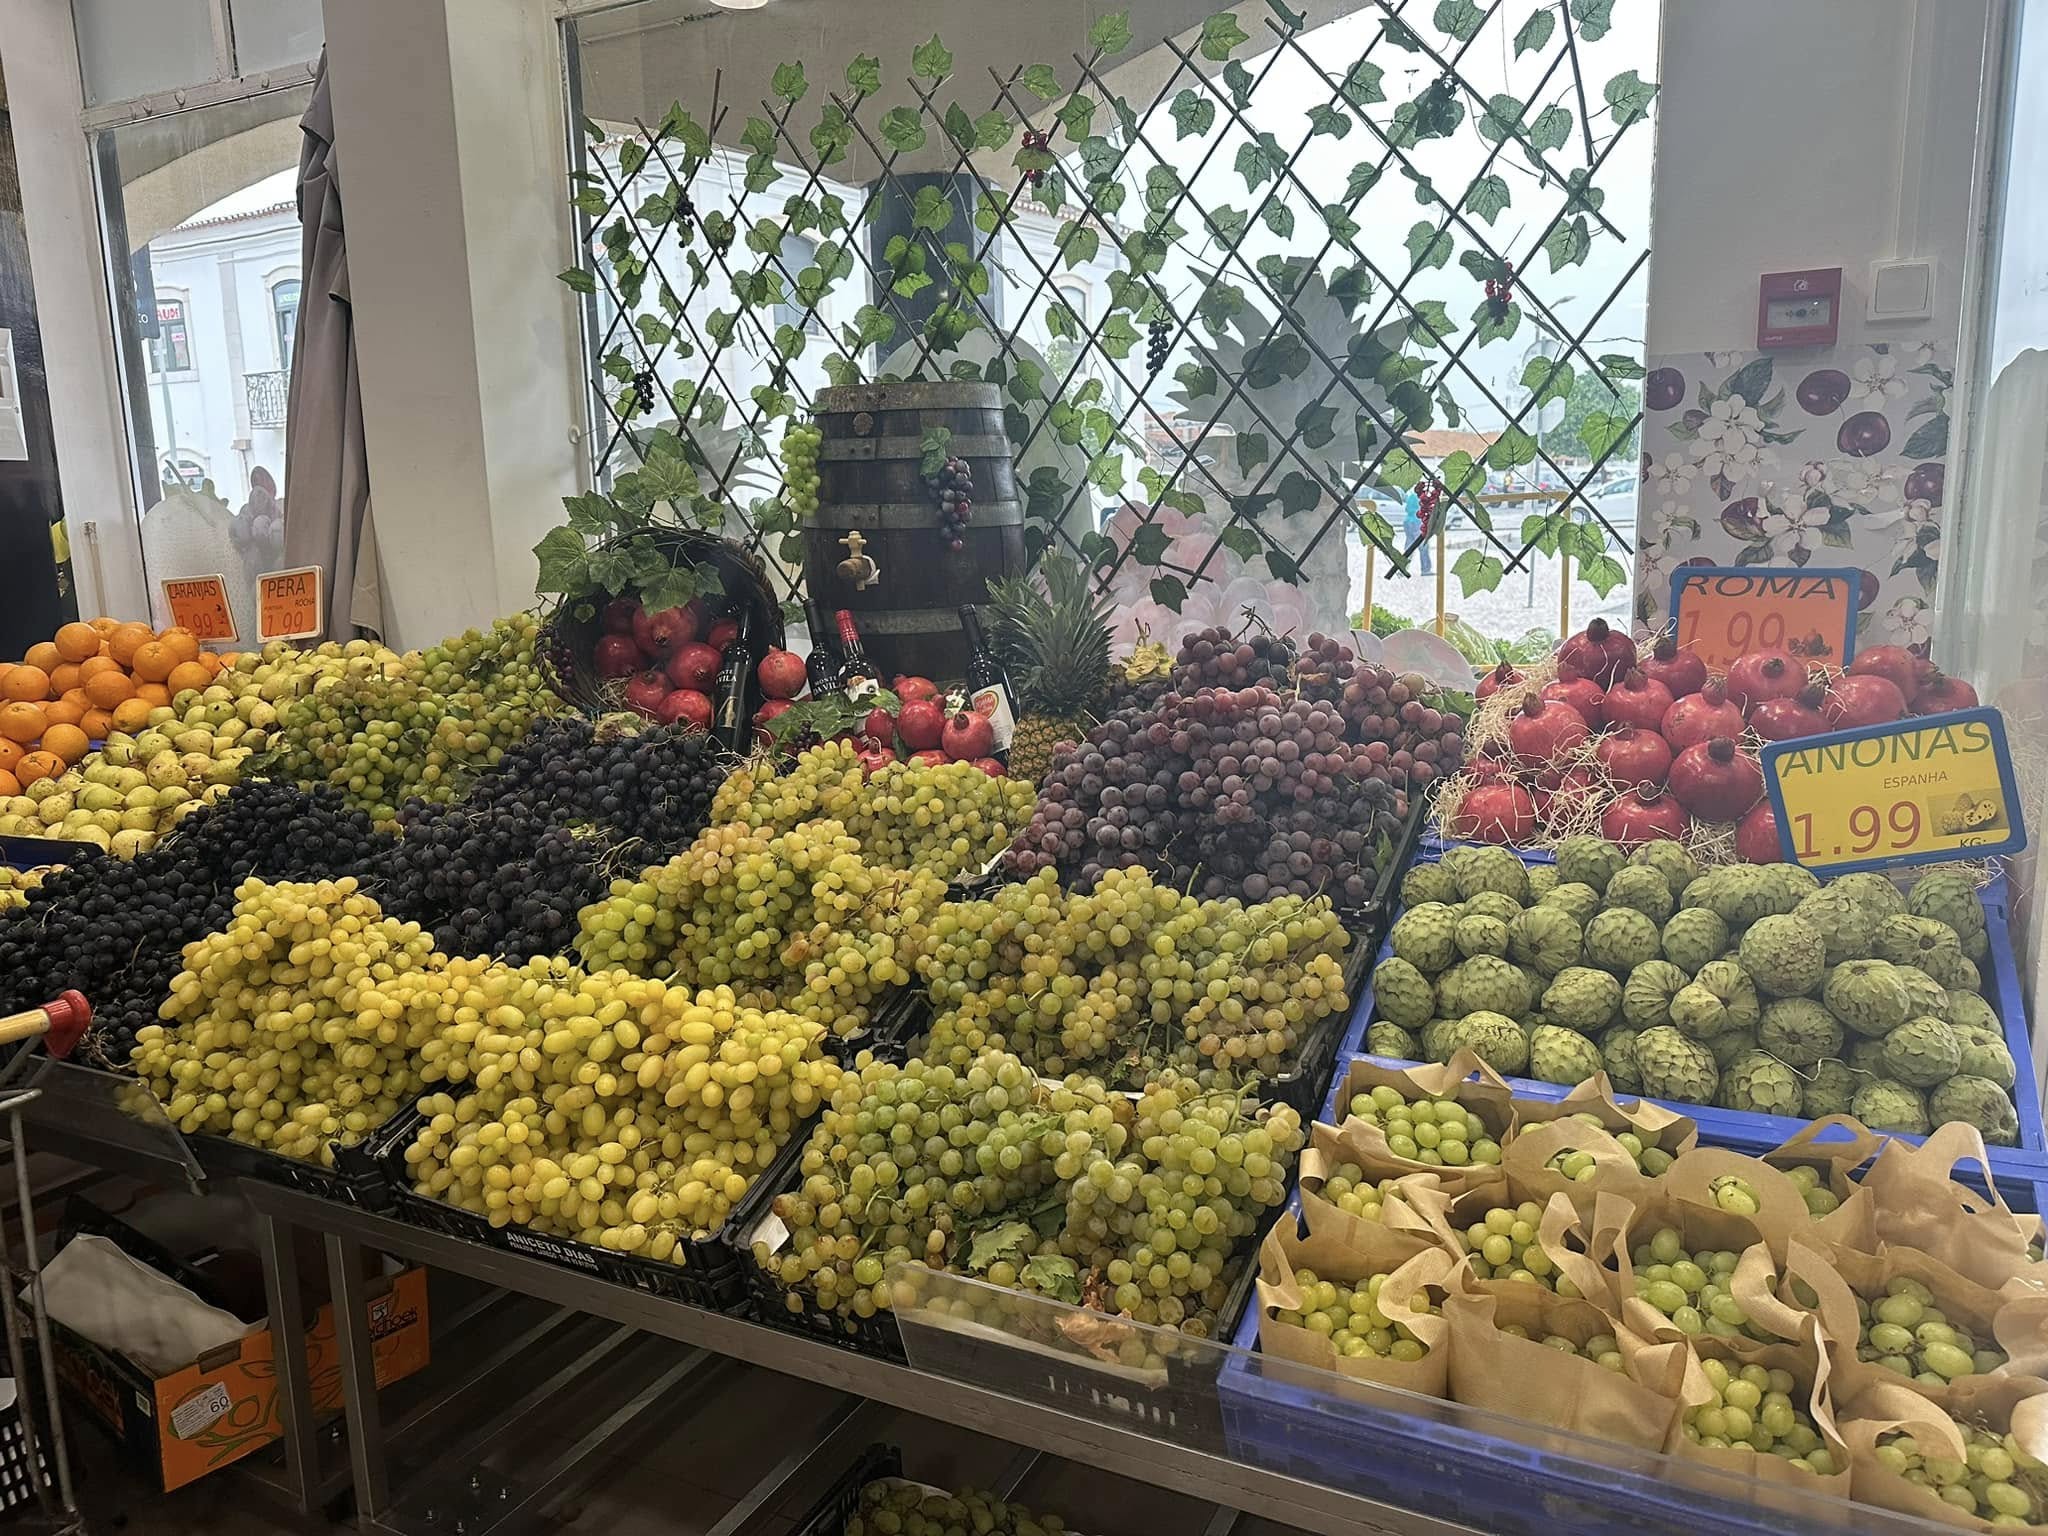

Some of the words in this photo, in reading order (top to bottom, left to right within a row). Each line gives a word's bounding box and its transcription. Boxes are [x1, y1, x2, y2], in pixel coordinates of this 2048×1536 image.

[168, 581, 217, 600] LARANJAS
[267, 576, 306, 599] PERA
[1681, 575, 1836, 600] ROMA
[1782, 722, 1991, 778] ANONAS
[1883, 770, 1948, 790] ESPANHA
[1794, 800, 1921, 859] 1.99
[506, 1231, 561, 1254] ANICETO
[562, 1246, 596, 1265] DIAS
